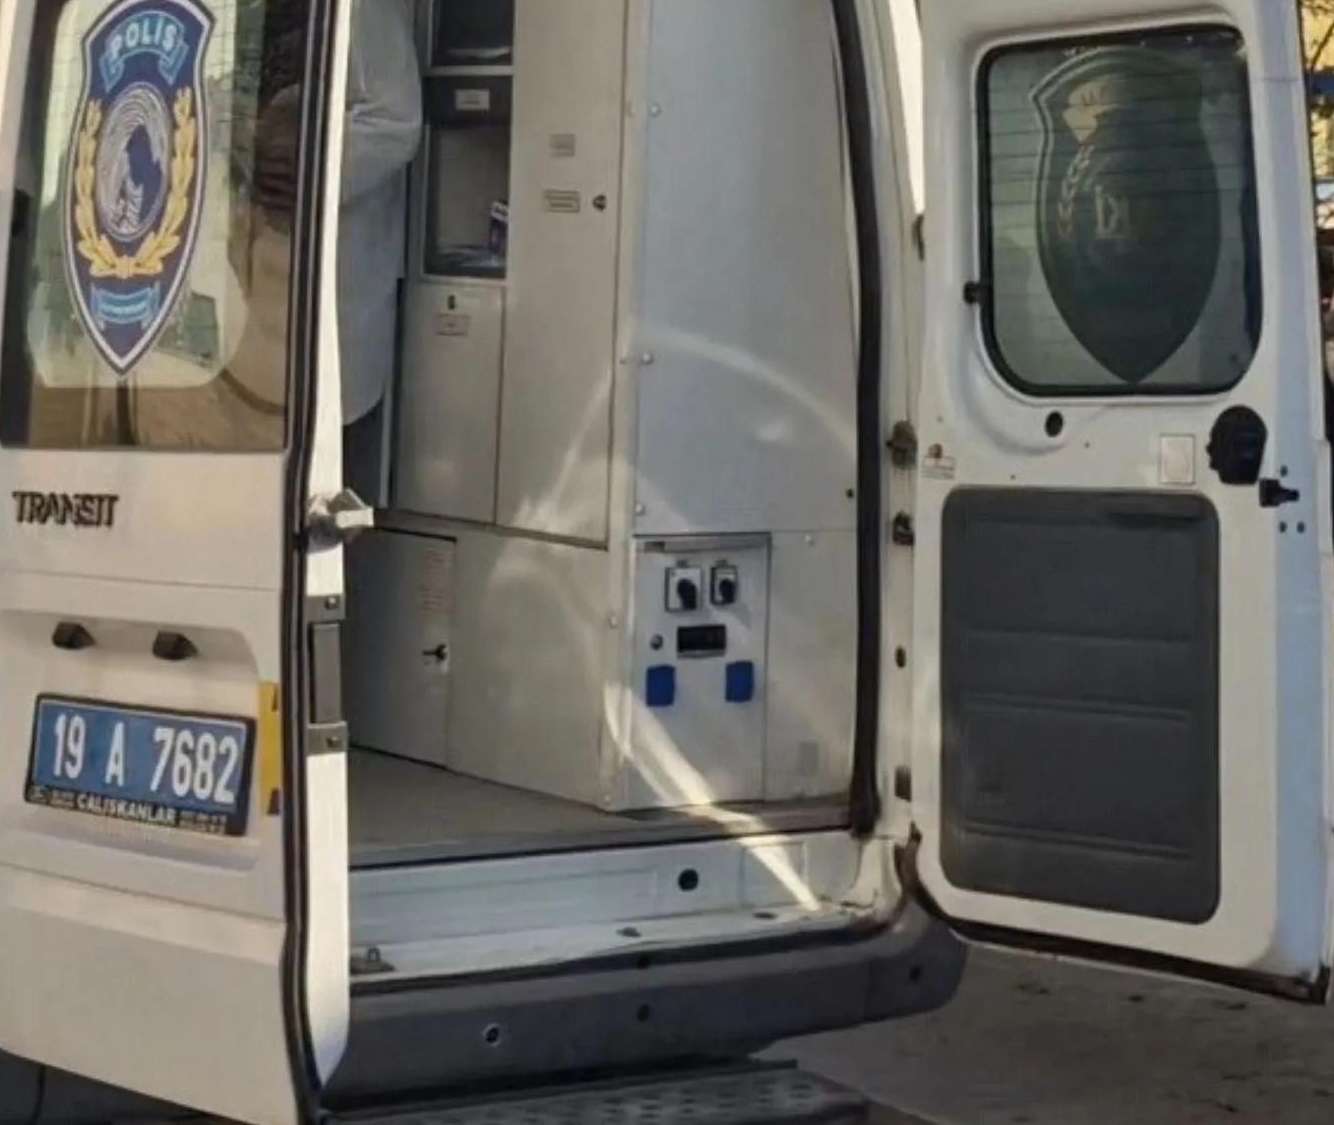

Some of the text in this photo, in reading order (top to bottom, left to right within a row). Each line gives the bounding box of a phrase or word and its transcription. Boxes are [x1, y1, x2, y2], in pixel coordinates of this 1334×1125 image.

[11, 491, 119, 527] TRANSIT
[53, 712, 240, 805] 19 A 7682
